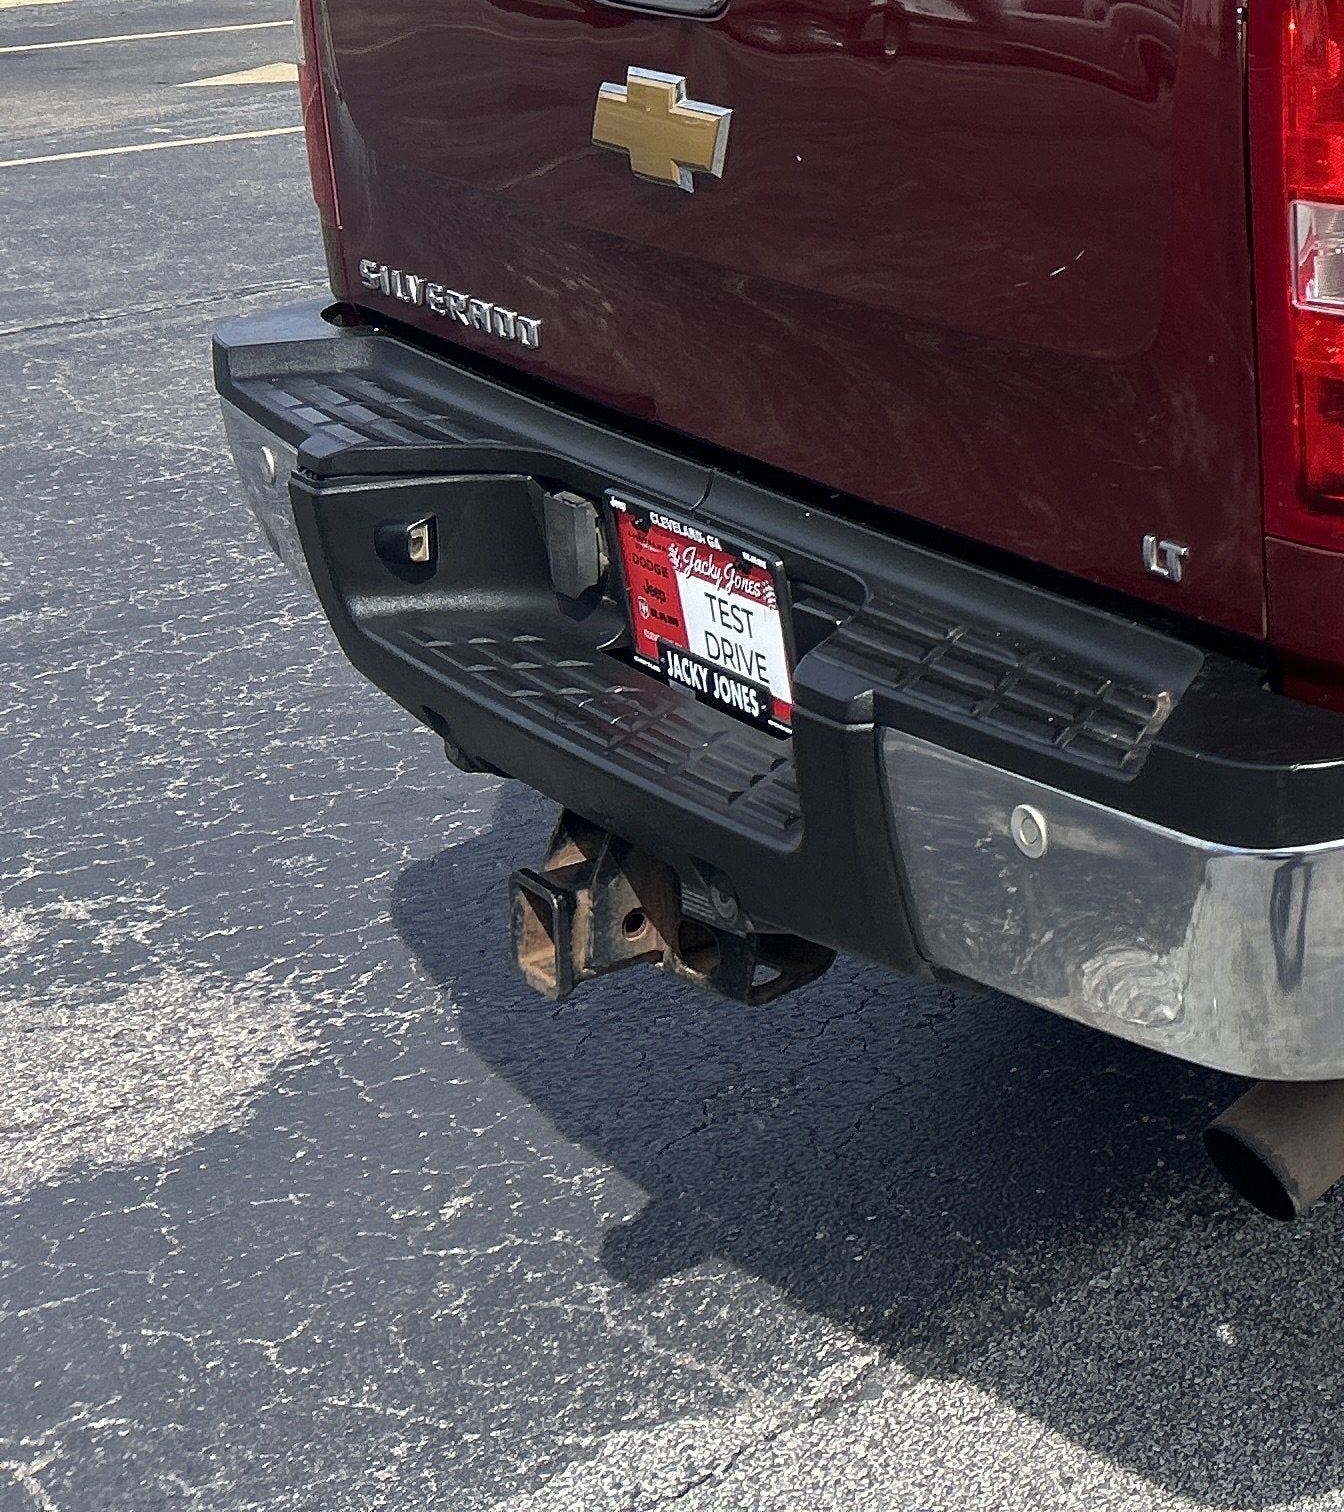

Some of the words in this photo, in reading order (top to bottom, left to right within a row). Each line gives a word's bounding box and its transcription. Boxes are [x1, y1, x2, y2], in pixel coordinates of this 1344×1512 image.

[359, 258, 542, 349] SILVERADO
[631, 552, 669, 579] DODGE
[682, 546, 722, 588] Jacky
[724, 562, 762, 597] Jones
[1143, 535, 1189, 582] LT
[704, 592, 753, 638] TEST
[704, 630, 770, 685] DRIVE
[666, 650, 709, 693] JACKY
[713, 671, 760, 718] JONES
